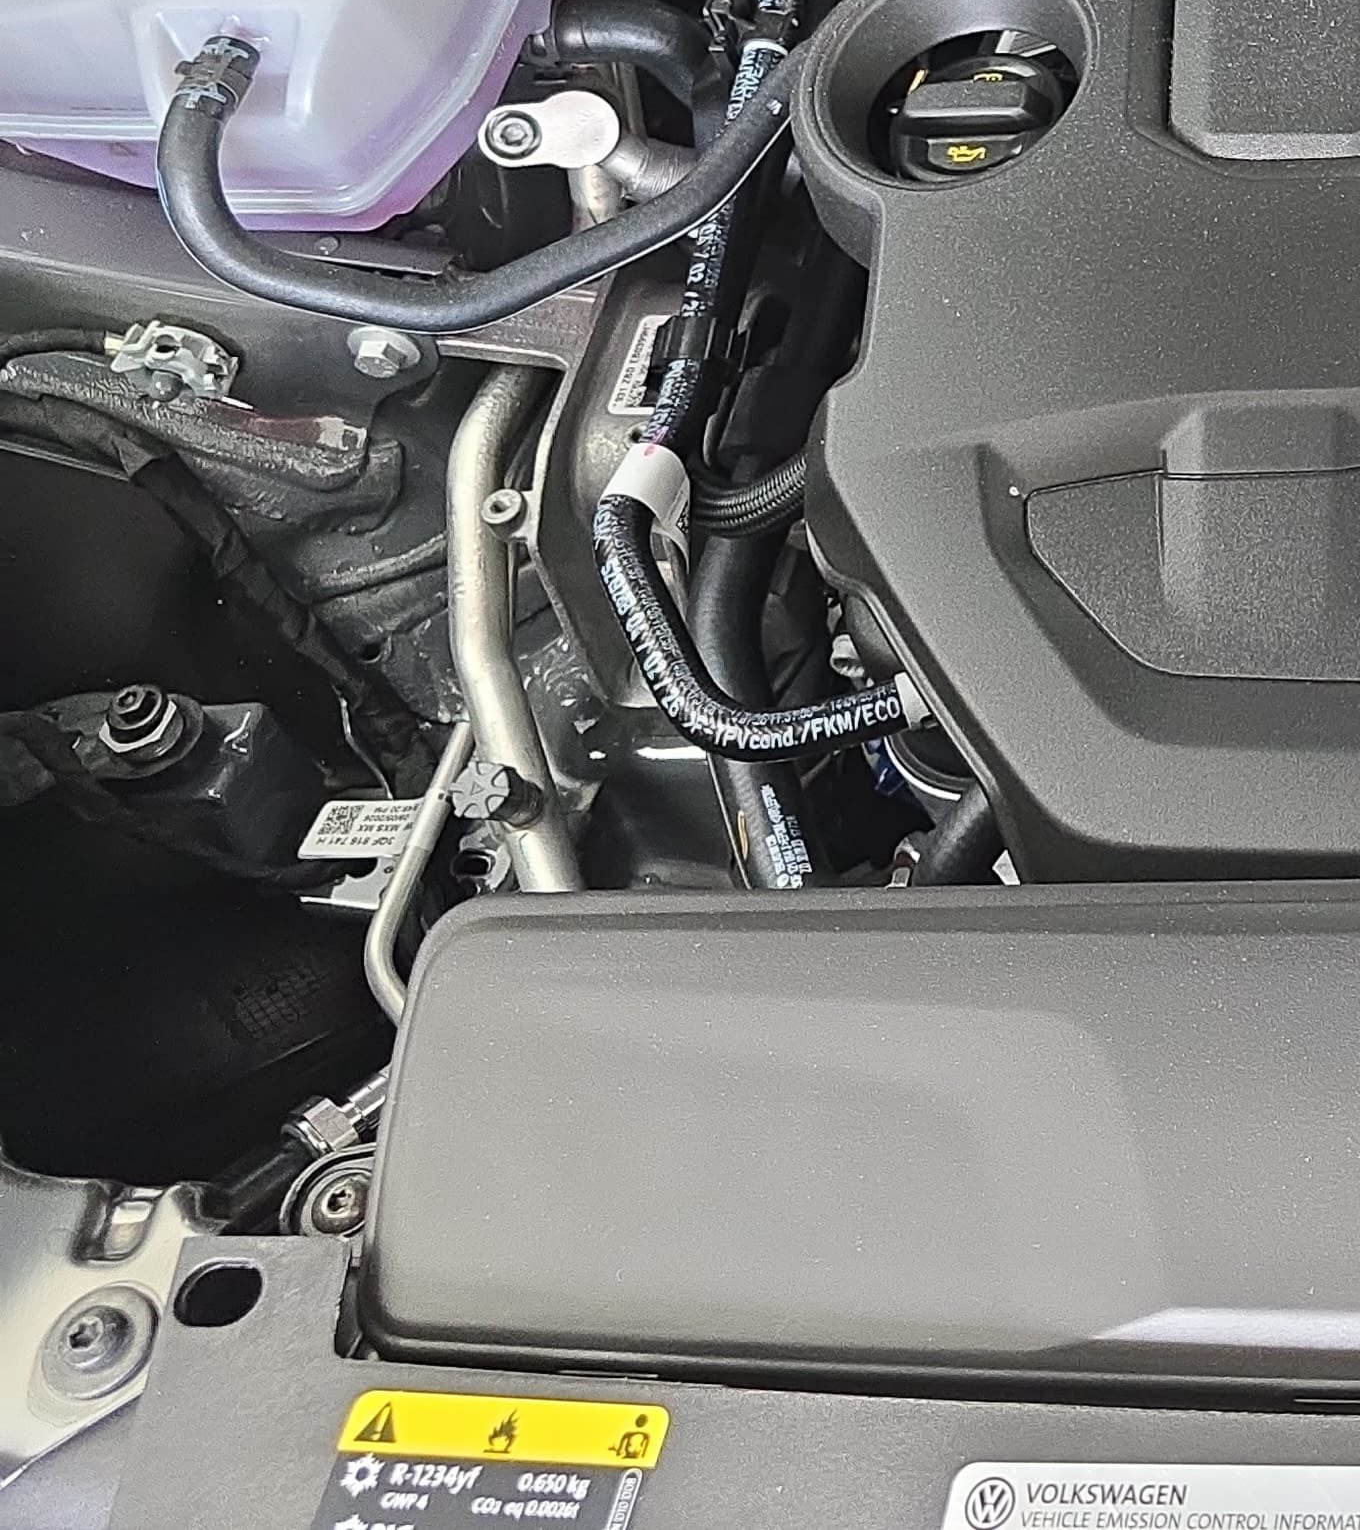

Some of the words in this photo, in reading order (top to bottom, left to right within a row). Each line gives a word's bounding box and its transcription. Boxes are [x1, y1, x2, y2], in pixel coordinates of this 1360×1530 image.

[389, 1462, 484, 1495] R-1234yf
[517, 1472, 568, 1493] 0.650
[567, 1474, 591, 1500] kg
[380, 1492, 414, 1510] GWP
[1026, 1482, 1188, 1506] VOLKSWAGEN
[1021, 1511, 1090, 1529] VEHICLE
[1096, 1512, 1182, 1529] EMISSION
[1187, 1513, 1268, 1530] CONTROL
